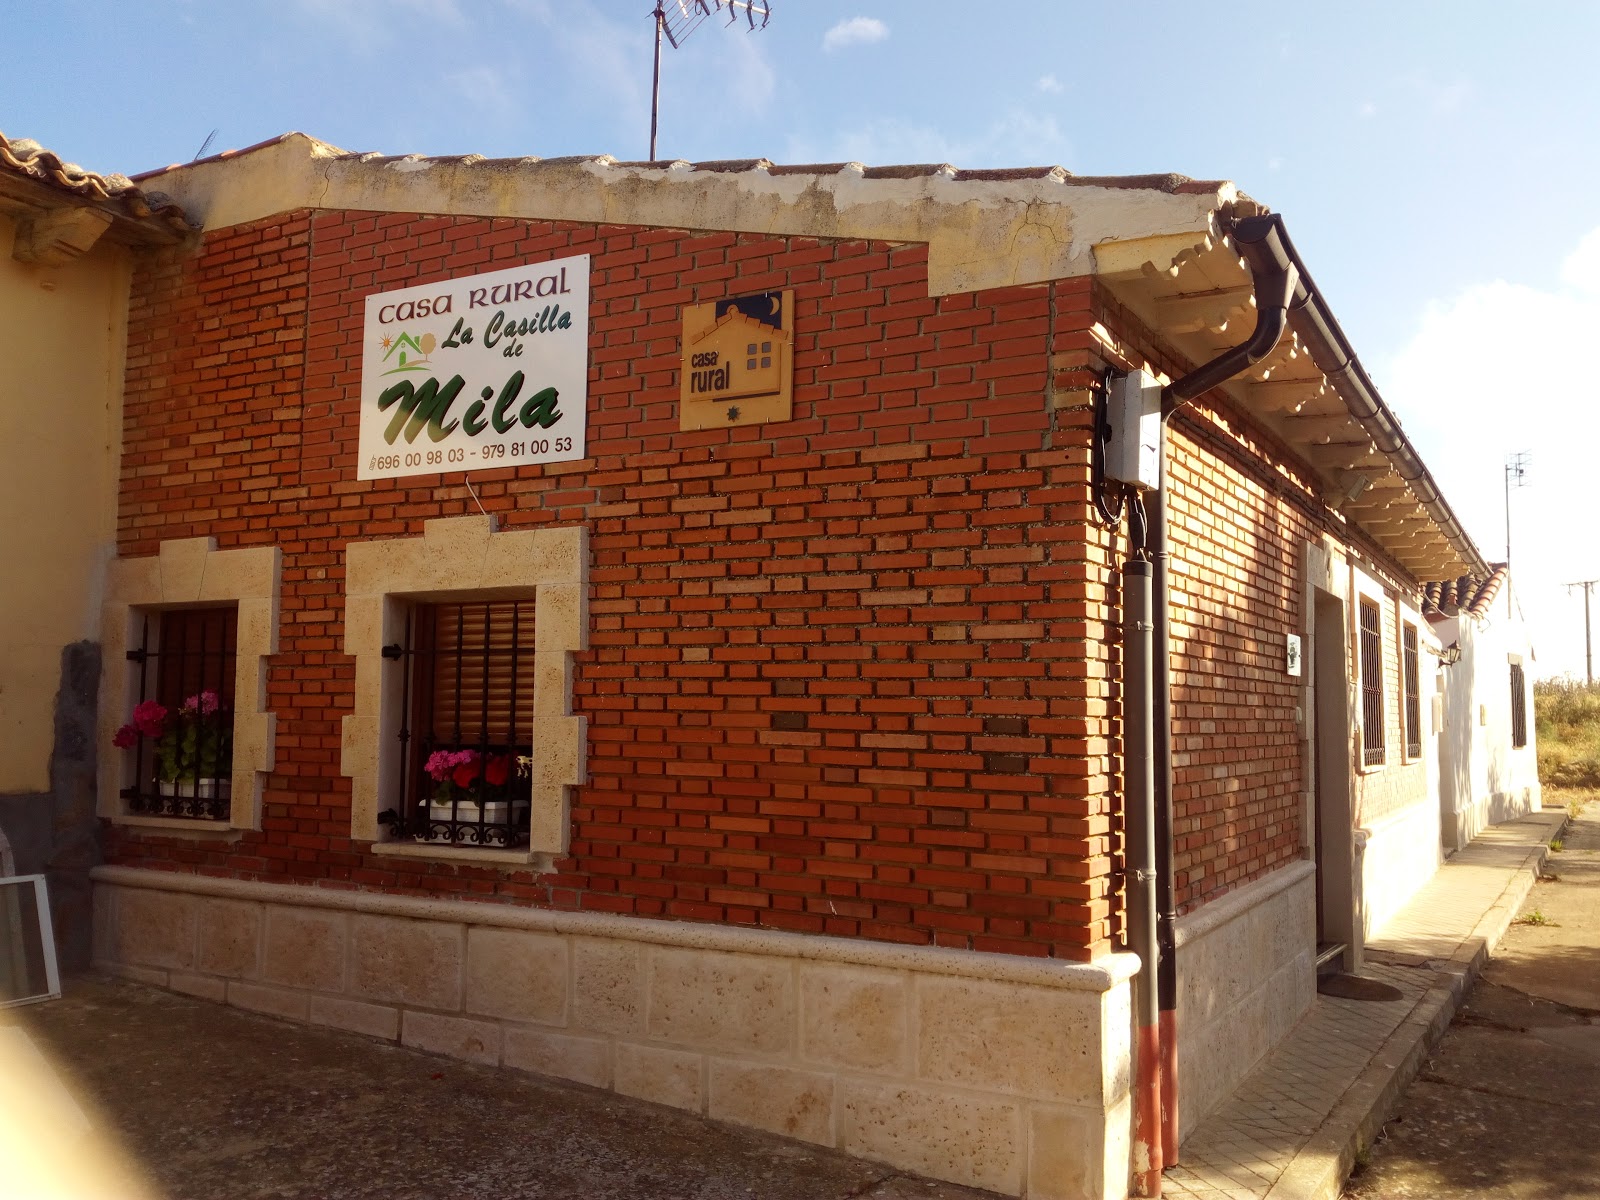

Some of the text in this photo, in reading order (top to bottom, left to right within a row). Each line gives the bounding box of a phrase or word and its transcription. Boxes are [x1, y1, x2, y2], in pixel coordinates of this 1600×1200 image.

[441, 303, 572, 349] La Casilla
[502, 338, 524, 358] de
[691, 350, 719, 368] casa
[690, 361, 730, 393] rural
[377, 370, 563, 446] Mila
[377, 454, 400, 470] 696
[405, 452, 421, 467] 00
[426, 450, 443, 465] 98
[448, 448, 465, 463] 03
[482, 443, 505, 460] 979
[511, 441, 525, 457] 81
[530, 439, 549, 455] 00
[555, 436, 572, 453] 53
